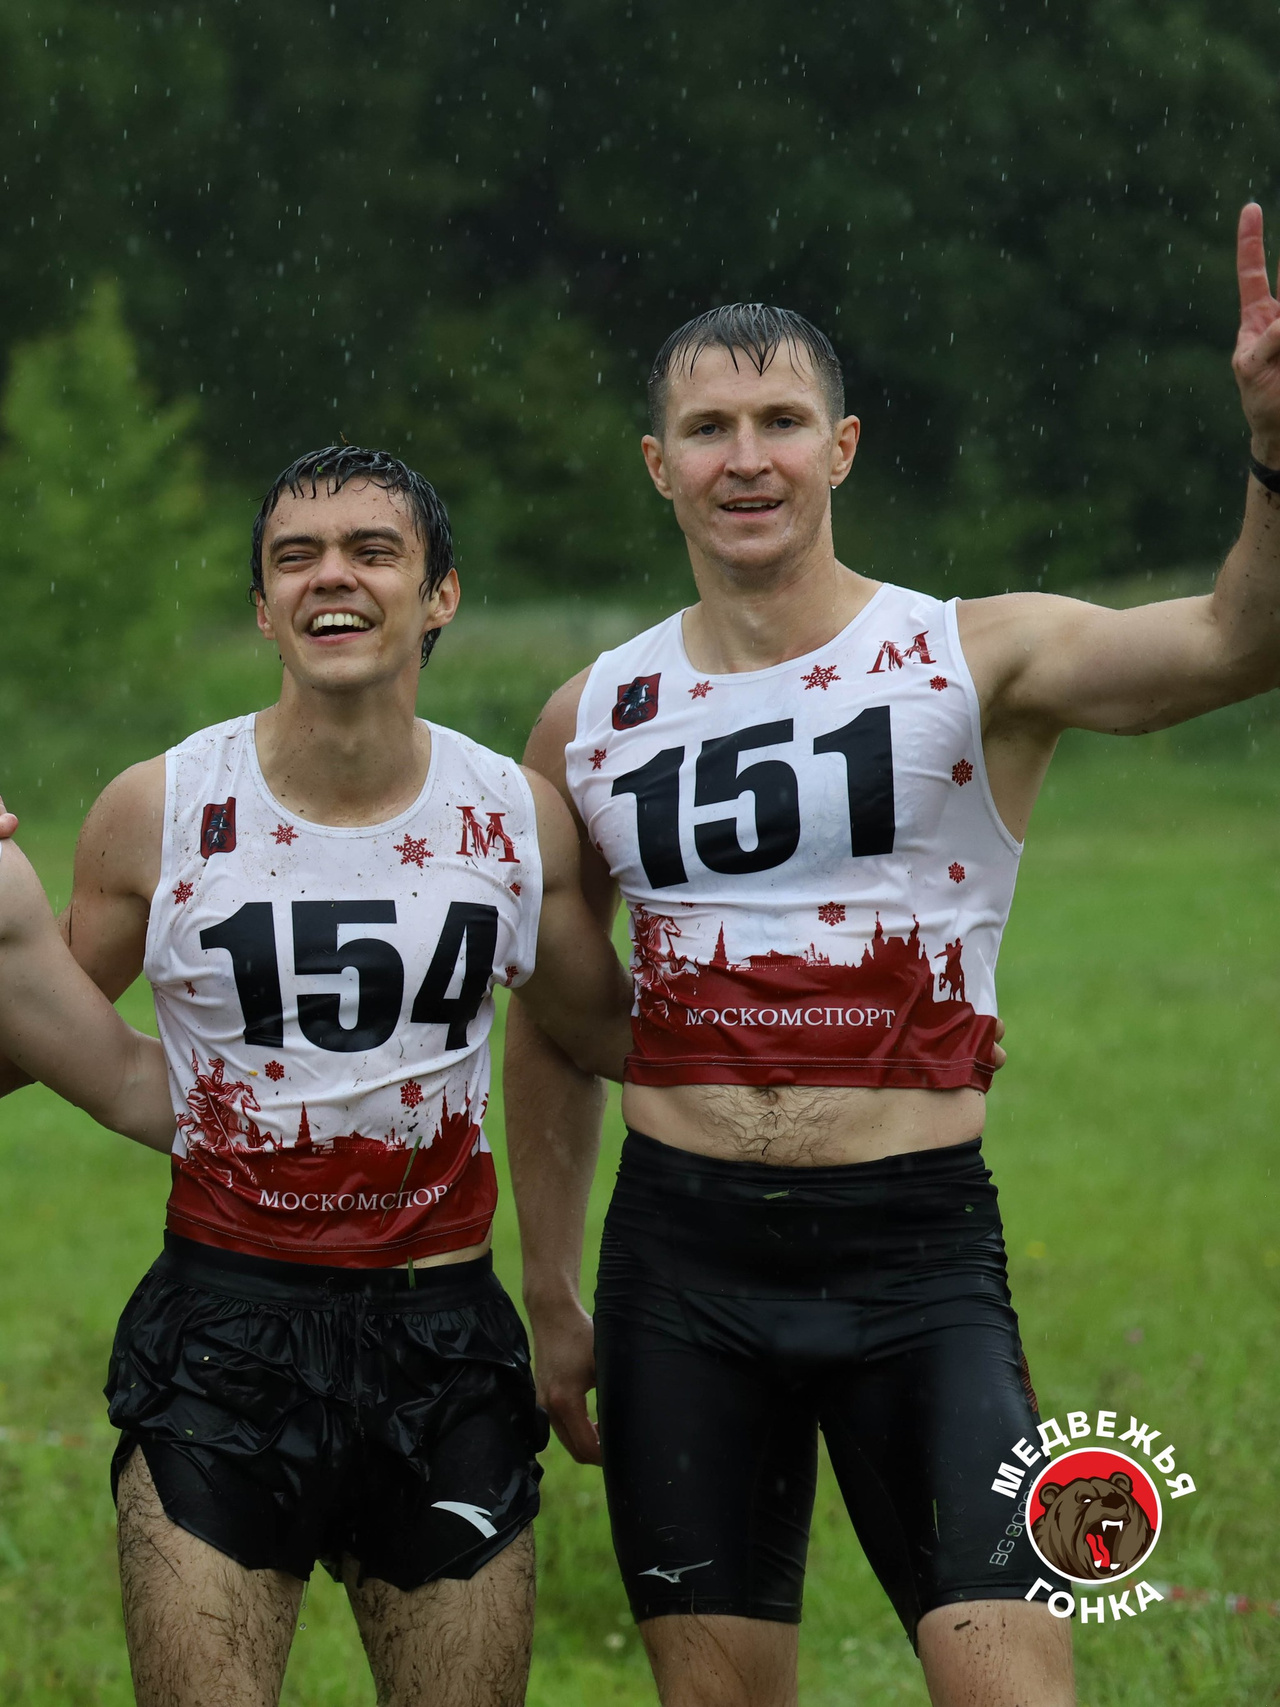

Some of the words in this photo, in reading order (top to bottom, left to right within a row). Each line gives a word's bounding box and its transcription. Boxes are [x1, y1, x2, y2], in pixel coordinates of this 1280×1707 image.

[611, 705, 896, 890] 151
[199, 899, 499, 1053] 154
[685, 1007, 896, 1029] МОСКОМСПОРТ
[258, 1183, 453, 1212] МОСКОМСПОР
